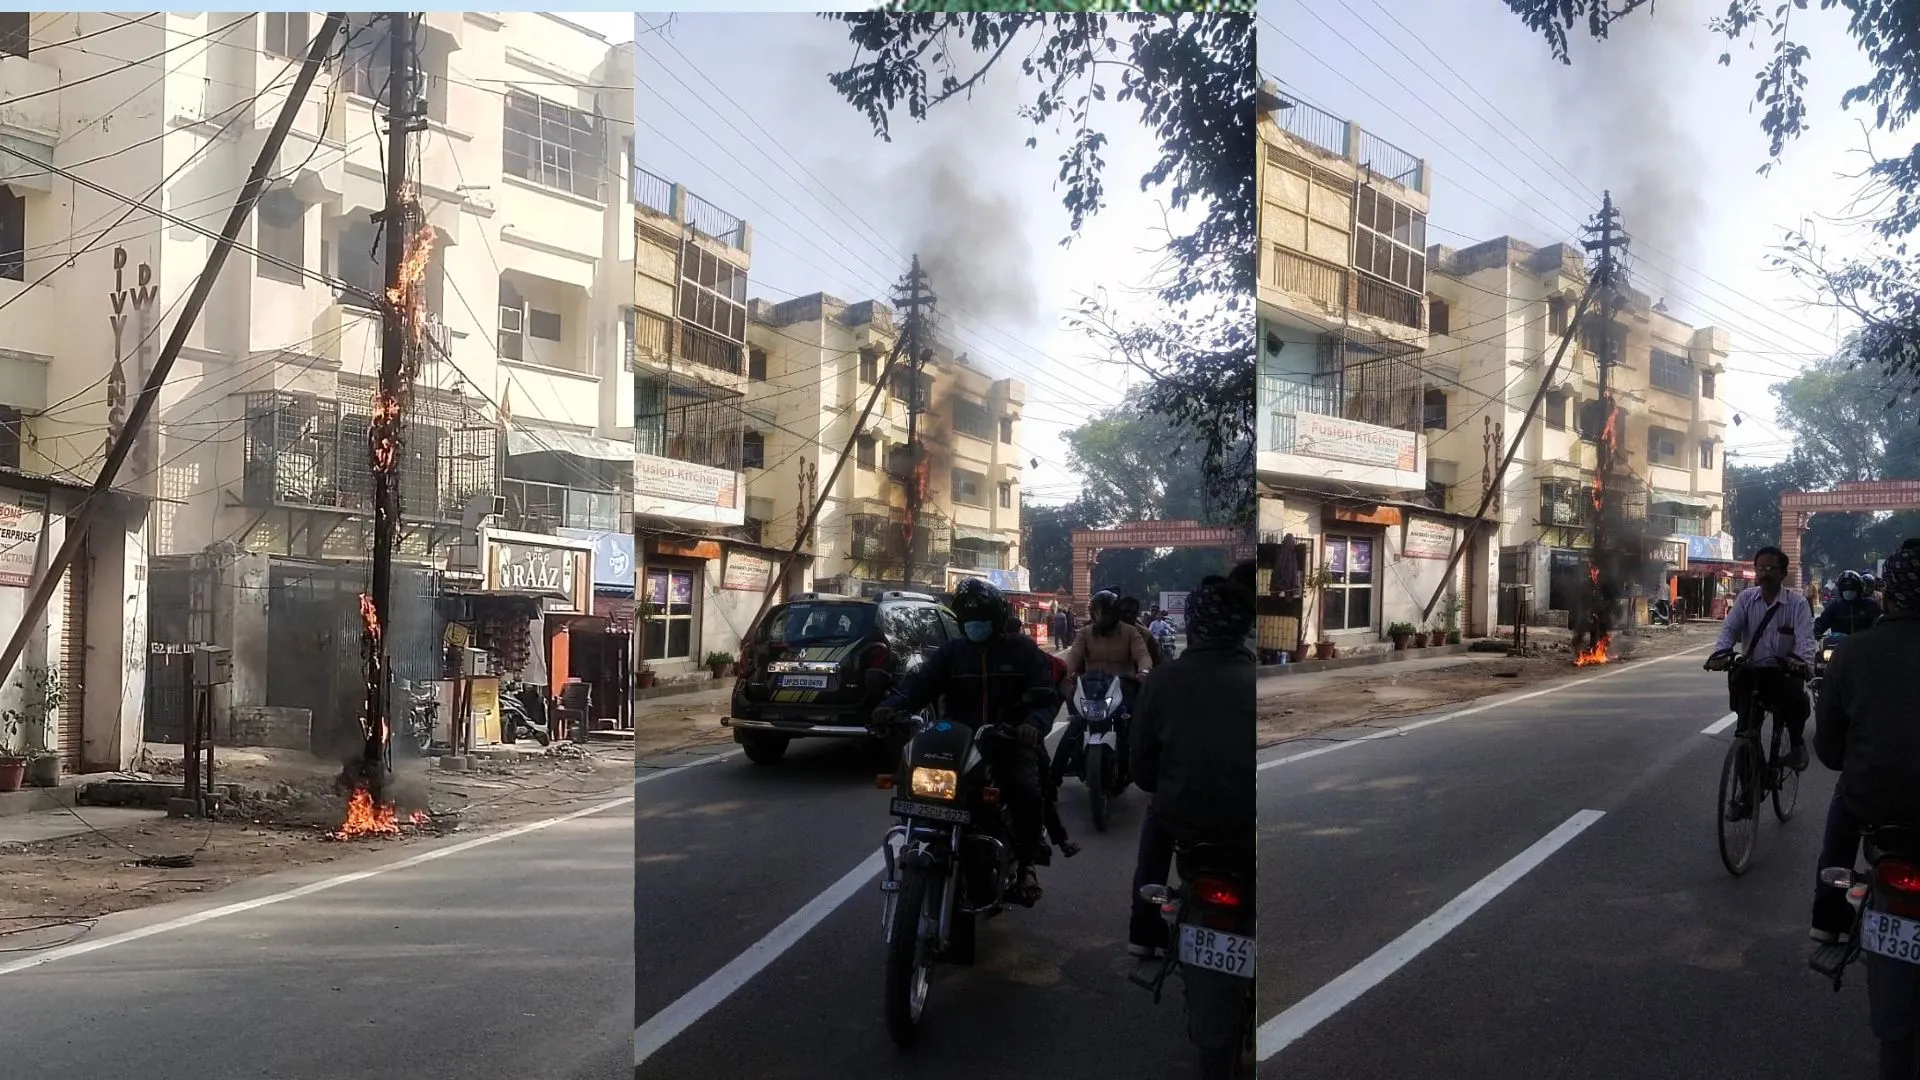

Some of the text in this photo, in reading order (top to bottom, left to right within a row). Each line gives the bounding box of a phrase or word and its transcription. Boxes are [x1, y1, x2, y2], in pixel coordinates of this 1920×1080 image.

[1311, 421, 1352, 439] Fusion
[1356, 429, 1399, 447] Kitchen
[635, 460, 675, 478] Fusion
[678, 467, 719, 486] Kitchen
[512, 557, 559, 589] RAAZ
[1879, 915, 1901, 937] BR
[1195, 929, 1248, 956] BR 24
[1195, 947, 1247, 973] Y3307
